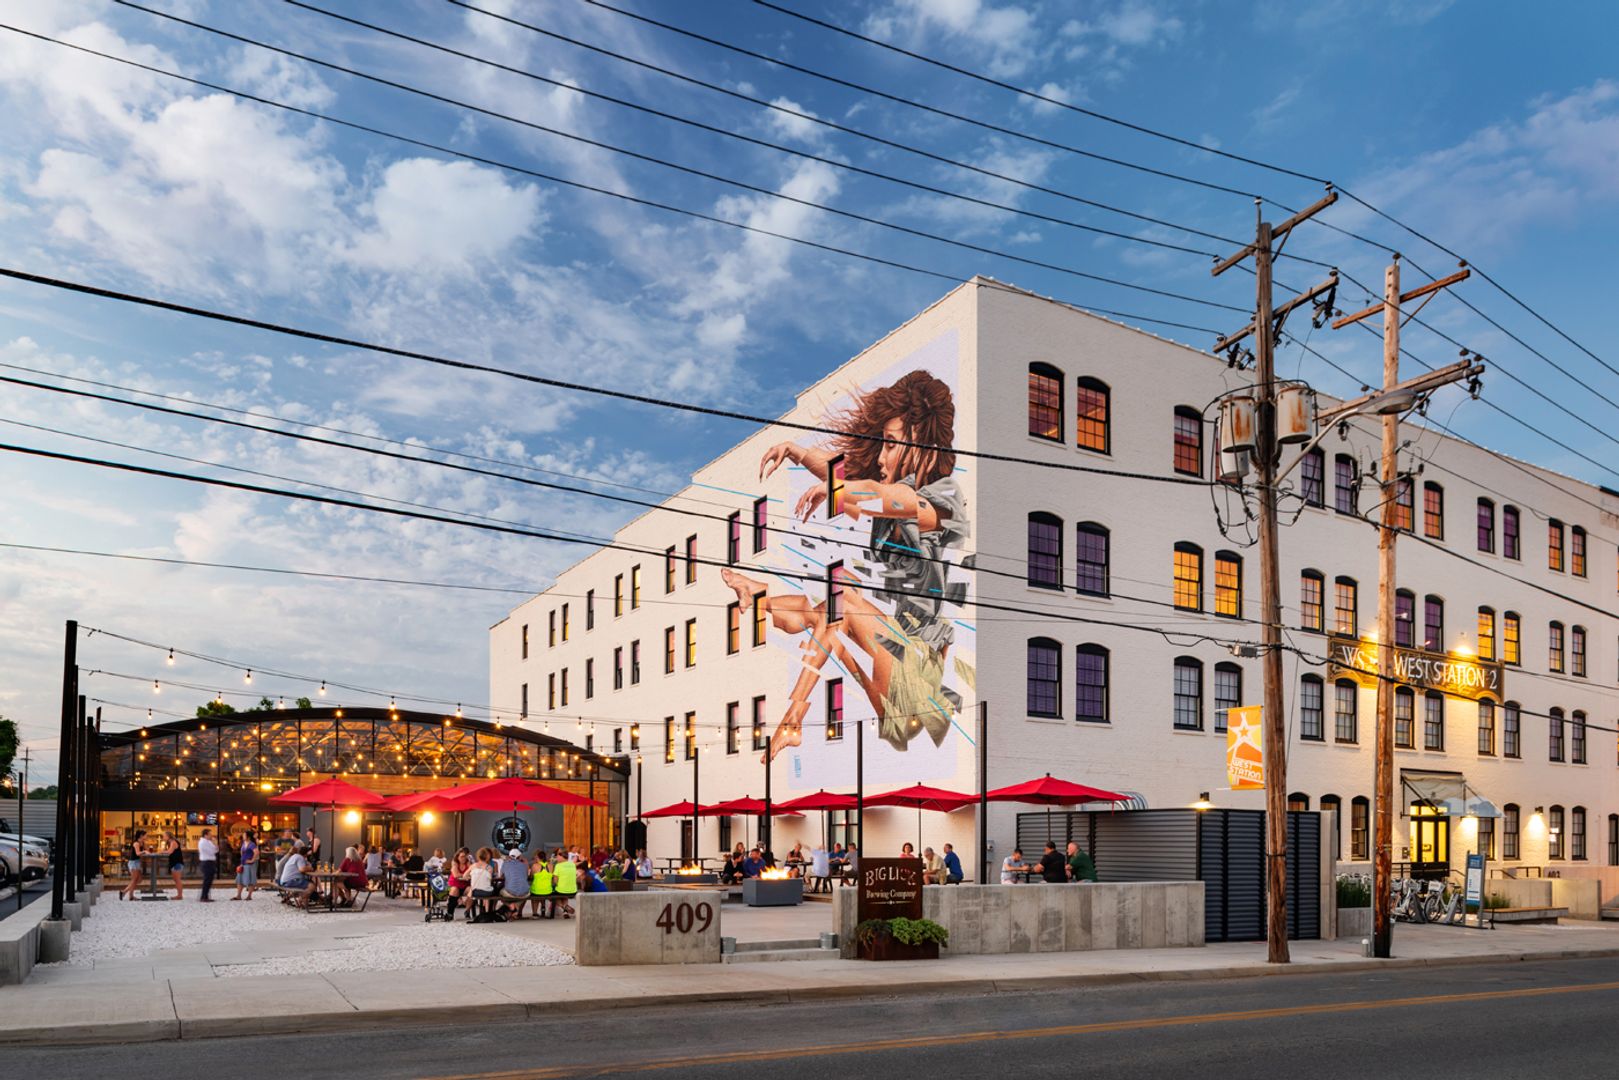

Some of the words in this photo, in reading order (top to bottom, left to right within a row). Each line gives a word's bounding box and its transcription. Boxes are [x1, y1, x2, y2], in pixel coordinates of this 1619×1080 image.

[1394, 654, 1430, 679] WEST
[1433, 661, 1486, 688] STATION
[1489, 670, 1498, 690] 2
[865, 866, 887, 886] BIG
[656, 902, 713, 935] 409
